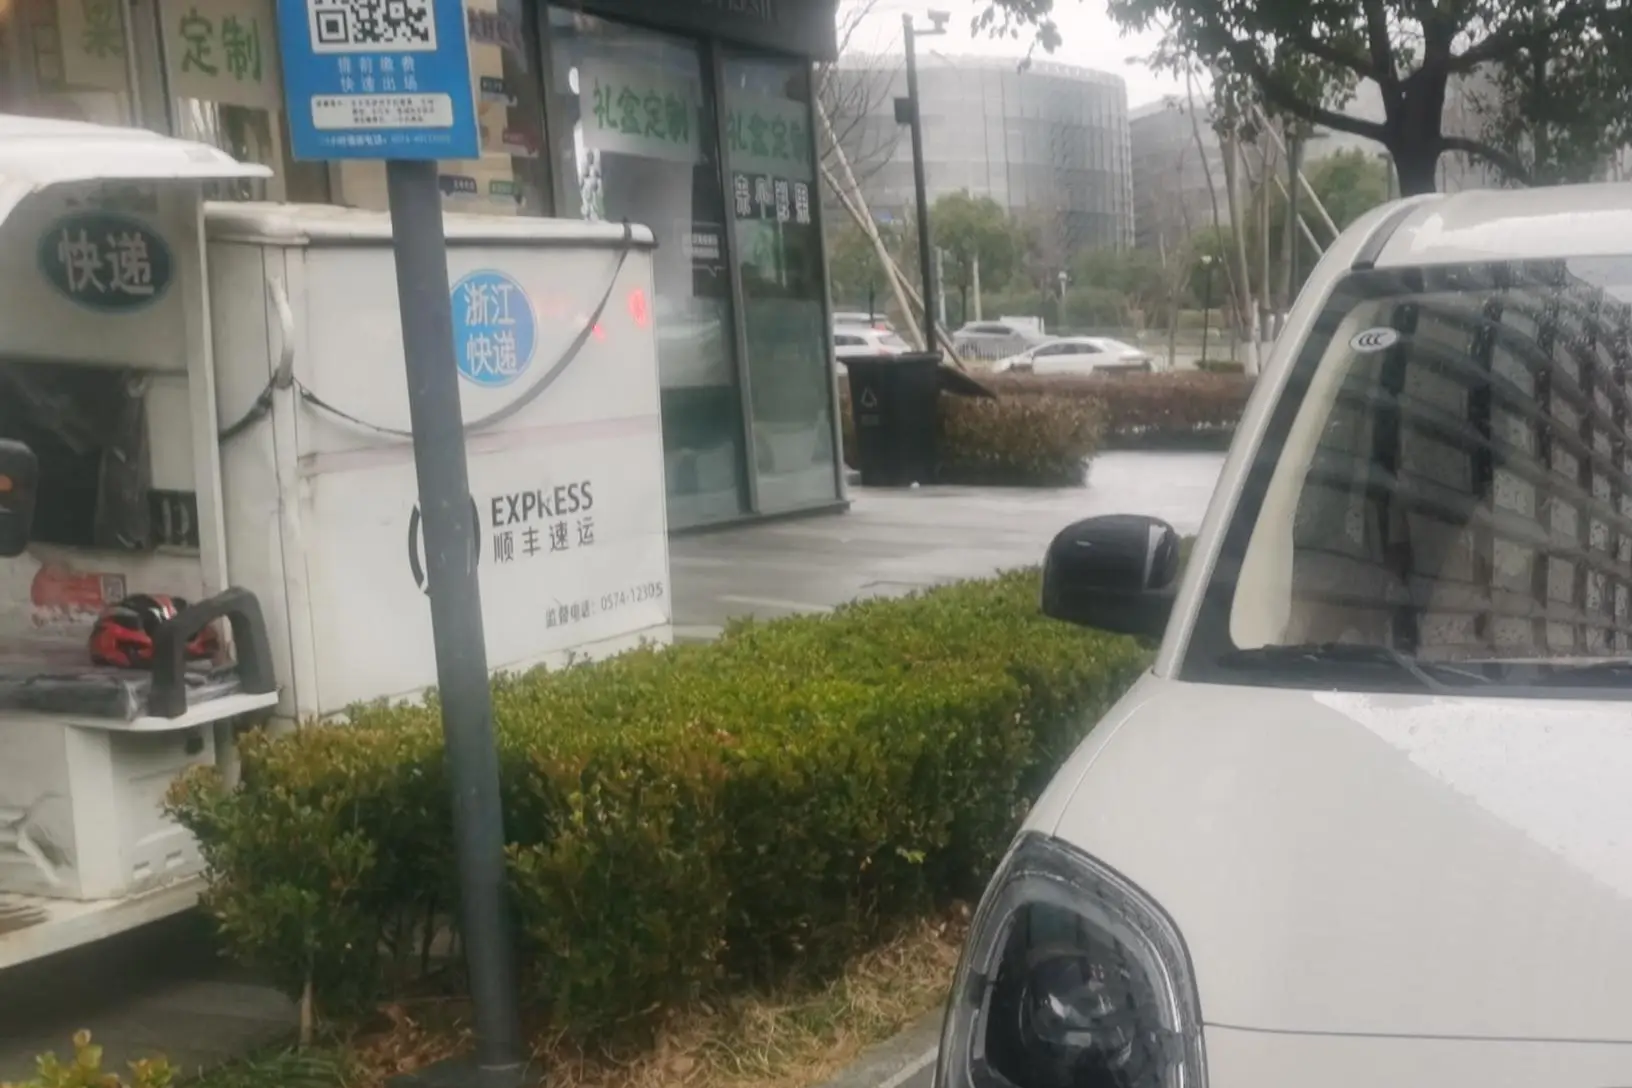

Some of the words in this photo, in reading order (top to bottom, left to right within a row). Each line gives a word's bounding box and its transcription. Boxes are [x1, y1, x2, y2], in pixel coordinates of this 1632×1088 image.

[180, 8, 262, 82] 定制
[58, 228, 154, 294] 快递
[464, 282, 516, 327] 浙江
[466, 331, 521, 376] 快递
[491, 480, 594, 528] EXPRESS
[493, 516, 595, 563] 顺丰速运
